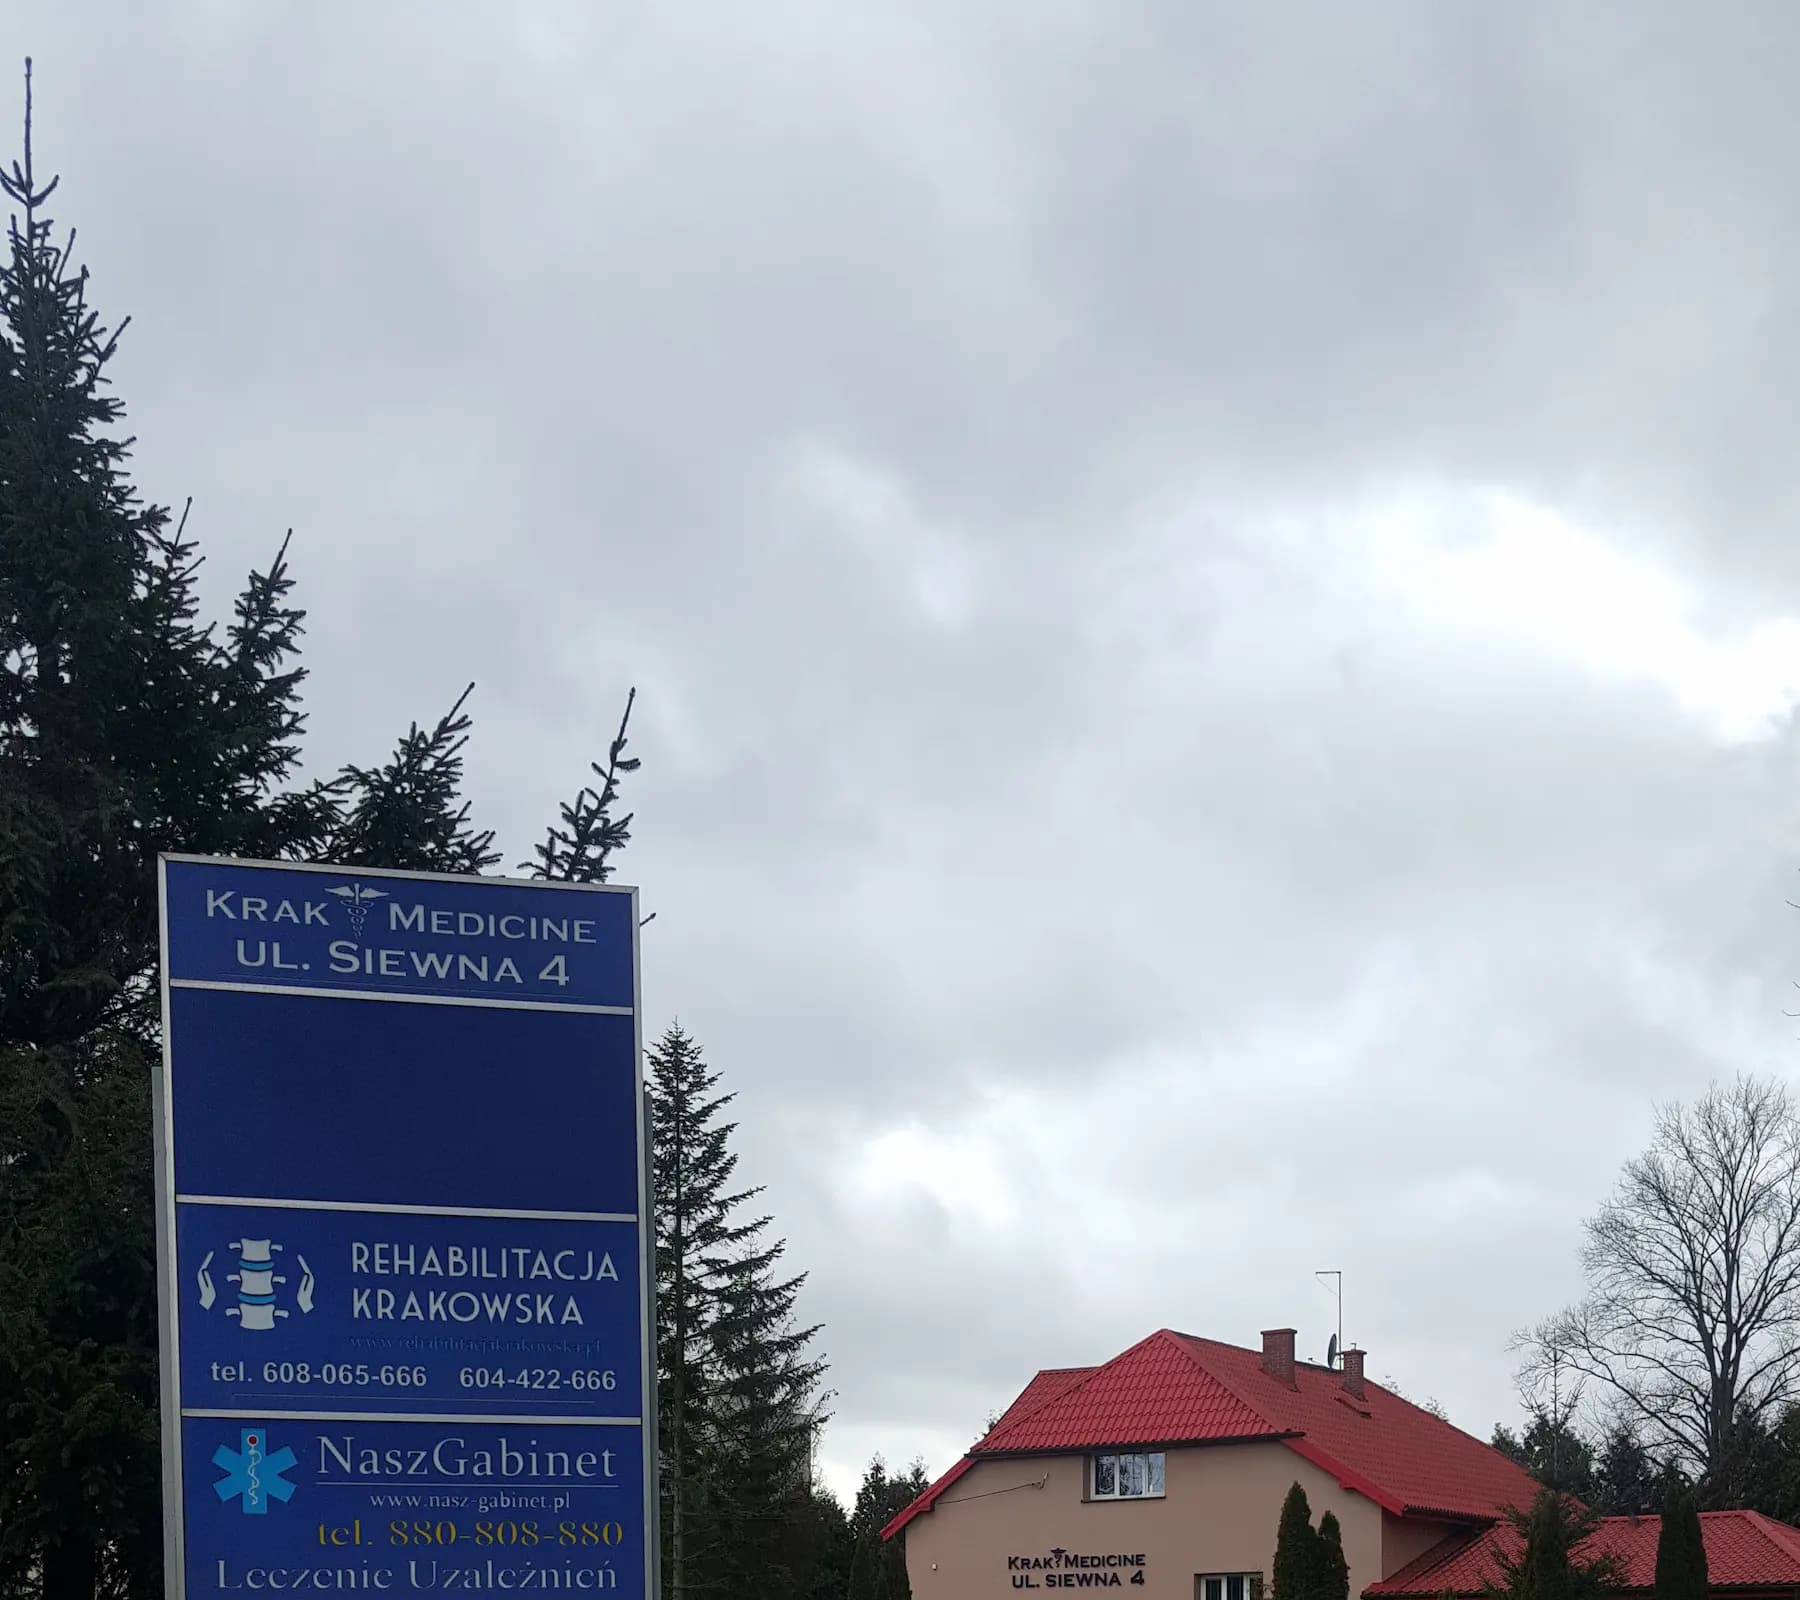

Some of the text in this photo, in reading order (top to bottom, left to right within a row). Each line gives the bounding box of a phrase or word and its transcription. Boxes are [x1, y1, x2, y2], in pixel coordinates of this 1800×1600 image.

[206, 889, 598, 944] KRAK MEDICINE
[237, 939, 570, 987] UL. SIEWNA 4
[351, 1241, 620, 1282] REHABILITACJA
[351, 1287, 585, 1326] KRAKOWSKA
[210, 1360, 617, 1391] tel. 608-065-666 604-422-666
[316, 1435, 618, 1479] NaszGabinet
[369, 1490, 571, 1514] www.nasz-gabinet.pl
[317, 1519, 624, 1547] tel. 880-808-880
[216, 1559, 618, 1590] Leczenie Uzależnień
[1008, 1554, 1146, 1571] KRAK MEDICINE
[1012, 1569, 1145, 1588] UL. SIEWNA 4
